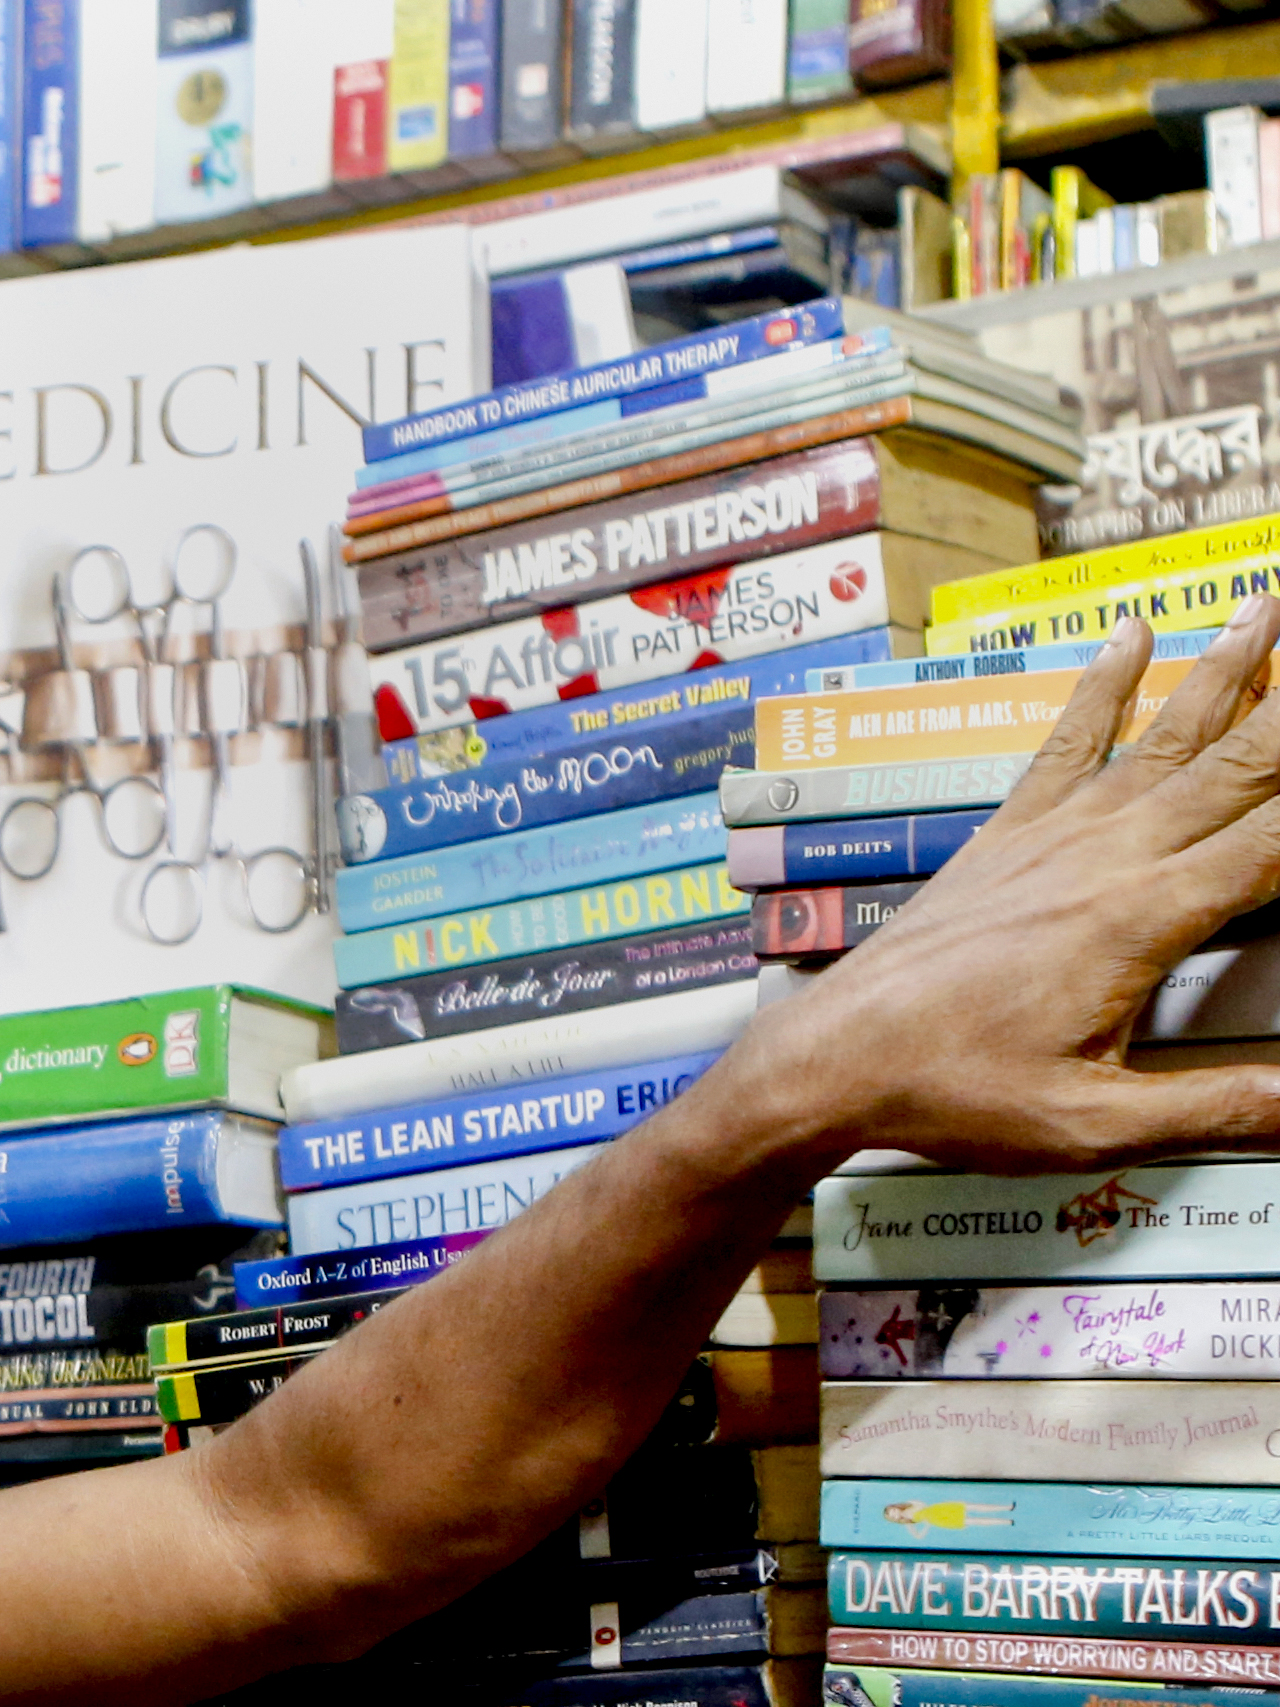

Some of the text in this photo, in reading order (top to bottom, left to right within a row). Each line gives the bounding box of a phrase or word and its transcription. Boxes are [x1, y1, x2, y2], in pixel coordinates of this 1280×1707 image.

[394, 407, 478, 448] HANDBOOK
[481, 399, 502, 421] TO
[504, 380, 570, 417] CHINESE
[573, 357, 664, 398] AURICULAR
[664, 335, 741, 371] THERAPY
[483, 527, 598, 604] JAMES
[604, 470, 821, 572] PATTERSON
[1151, 498, 1188, 530] ON
[667, 571, 776, 622] JAMES
[969, 620, 1037, 653] HOW
[1047, 611, 1086, 640] TO
[1095, 590, 1170, 633] TALK
[1180, 580, 1220, 612] TO
[632, 591, 820, 663] PATTERSON
[484, 619, 620, 705] Affair
[914, 651, 1027, 684] ANTHONY ROBBINS
[569, 673, 750, 735] The Secret Valley
[849, 700, 1019, 739] MEN ARE FROM MARS,
[781, 708, 811, 761] JOHN
[812, 706, 838, 758] GRAY
[521, 767, 555, 794] the
[673, 742, 733, 777] gregory
[844, 760, 1017, 807] BUSINESS
[803, 840, 893, 859] BOB DEITS
[374, 863, 438, 893] JOSTEIN
[625, 943, 652, 964] The
[666, 959, 727, 986] London
[437, 976, 508, 1016] Belle
[1165, 971, 1211, 989] Qarni
[4, 1043, 109, 1074] dictionary
[168, 1014, 197, 1071] DK
[304, 1129, 366, 1170] THE
[372, 1114, 456, 1160] LEAN
[462, 1087, 607, 1143] STARTUP
[843, 1202, 913, 1252] Jane
[922, 1210, 1044, 1236] COSTELLO
[1125, 1206, 1171, 1229] The
[1179, 1205, 1240, 1227] Time
[1249, 1202, 1275, 1225] of
[257, 1244, 430, 1291] Oxford of English
[219, 1314, 332, 1344] ROBERT FROST
[1062, 1289, 1167, 1335] Fairytale
[64, 1400, 111, 1417] JOHN
[837, 1404, 1261, 1450] Samantha Smythe's Modern Family Journal
[1078, 1530, 1125, 1540] PRETTY
[1129, 1532, 1169, 1542] LITTLE
[1174, 1533, 1210, 1542] LIARS
[1215, 1533, 1273, 1544] PREQUEL
[844, 1559, 949, 1617] DAVE
[962, 1563, 1106, 1623] BARRY
[1110, 1567, 1260, 1630] TALKS
[890, 1636, 938, 1658] HOW
[943, 1638, 969, 1660] TO
[975, 1639, 1029, 1664] STOP
[1033, 1642, 1147, 1671] WORRYING
[1152, 1648, 1199, 1672] AND
[1203, 1650, 1276, 1677] START
